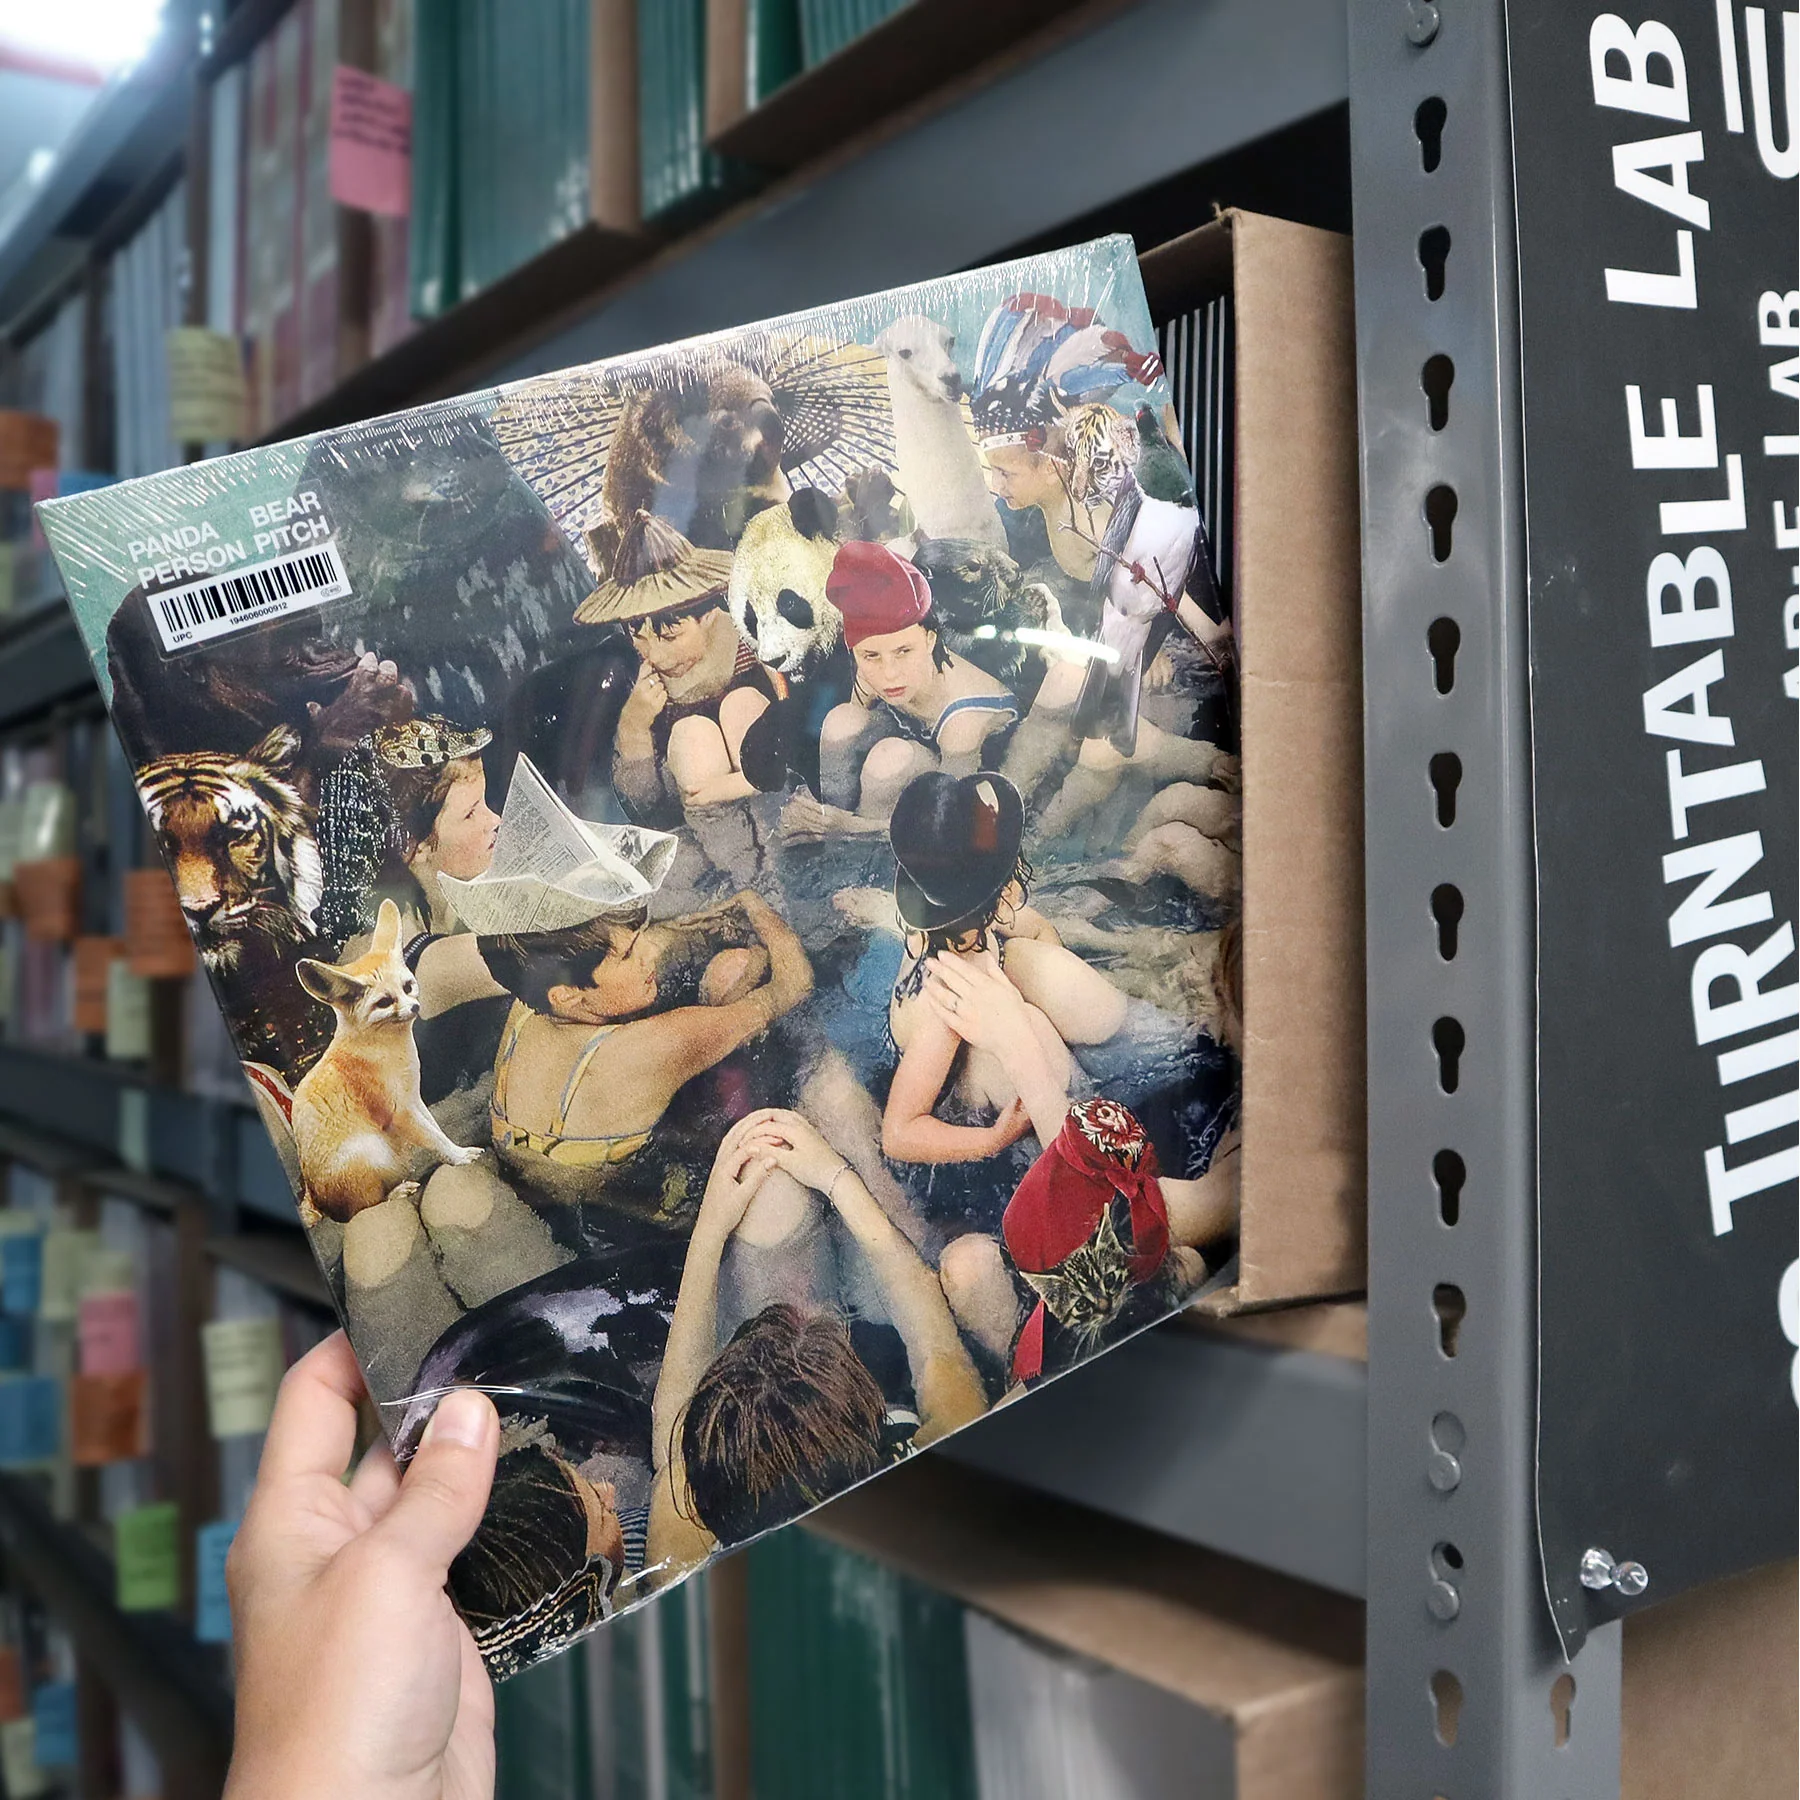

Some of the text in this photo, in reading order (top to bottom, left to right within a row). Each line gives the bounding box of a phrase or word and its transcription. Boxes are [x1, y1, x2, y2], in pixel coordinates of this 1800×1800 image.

[1589, 13, 1711, 310] LAB
[128, 490, 322, 564] PANDA BEAR
[137, 515, 331, 590] PERSON PITCH
[172, 602, 289, 644] UPC 194606000912
